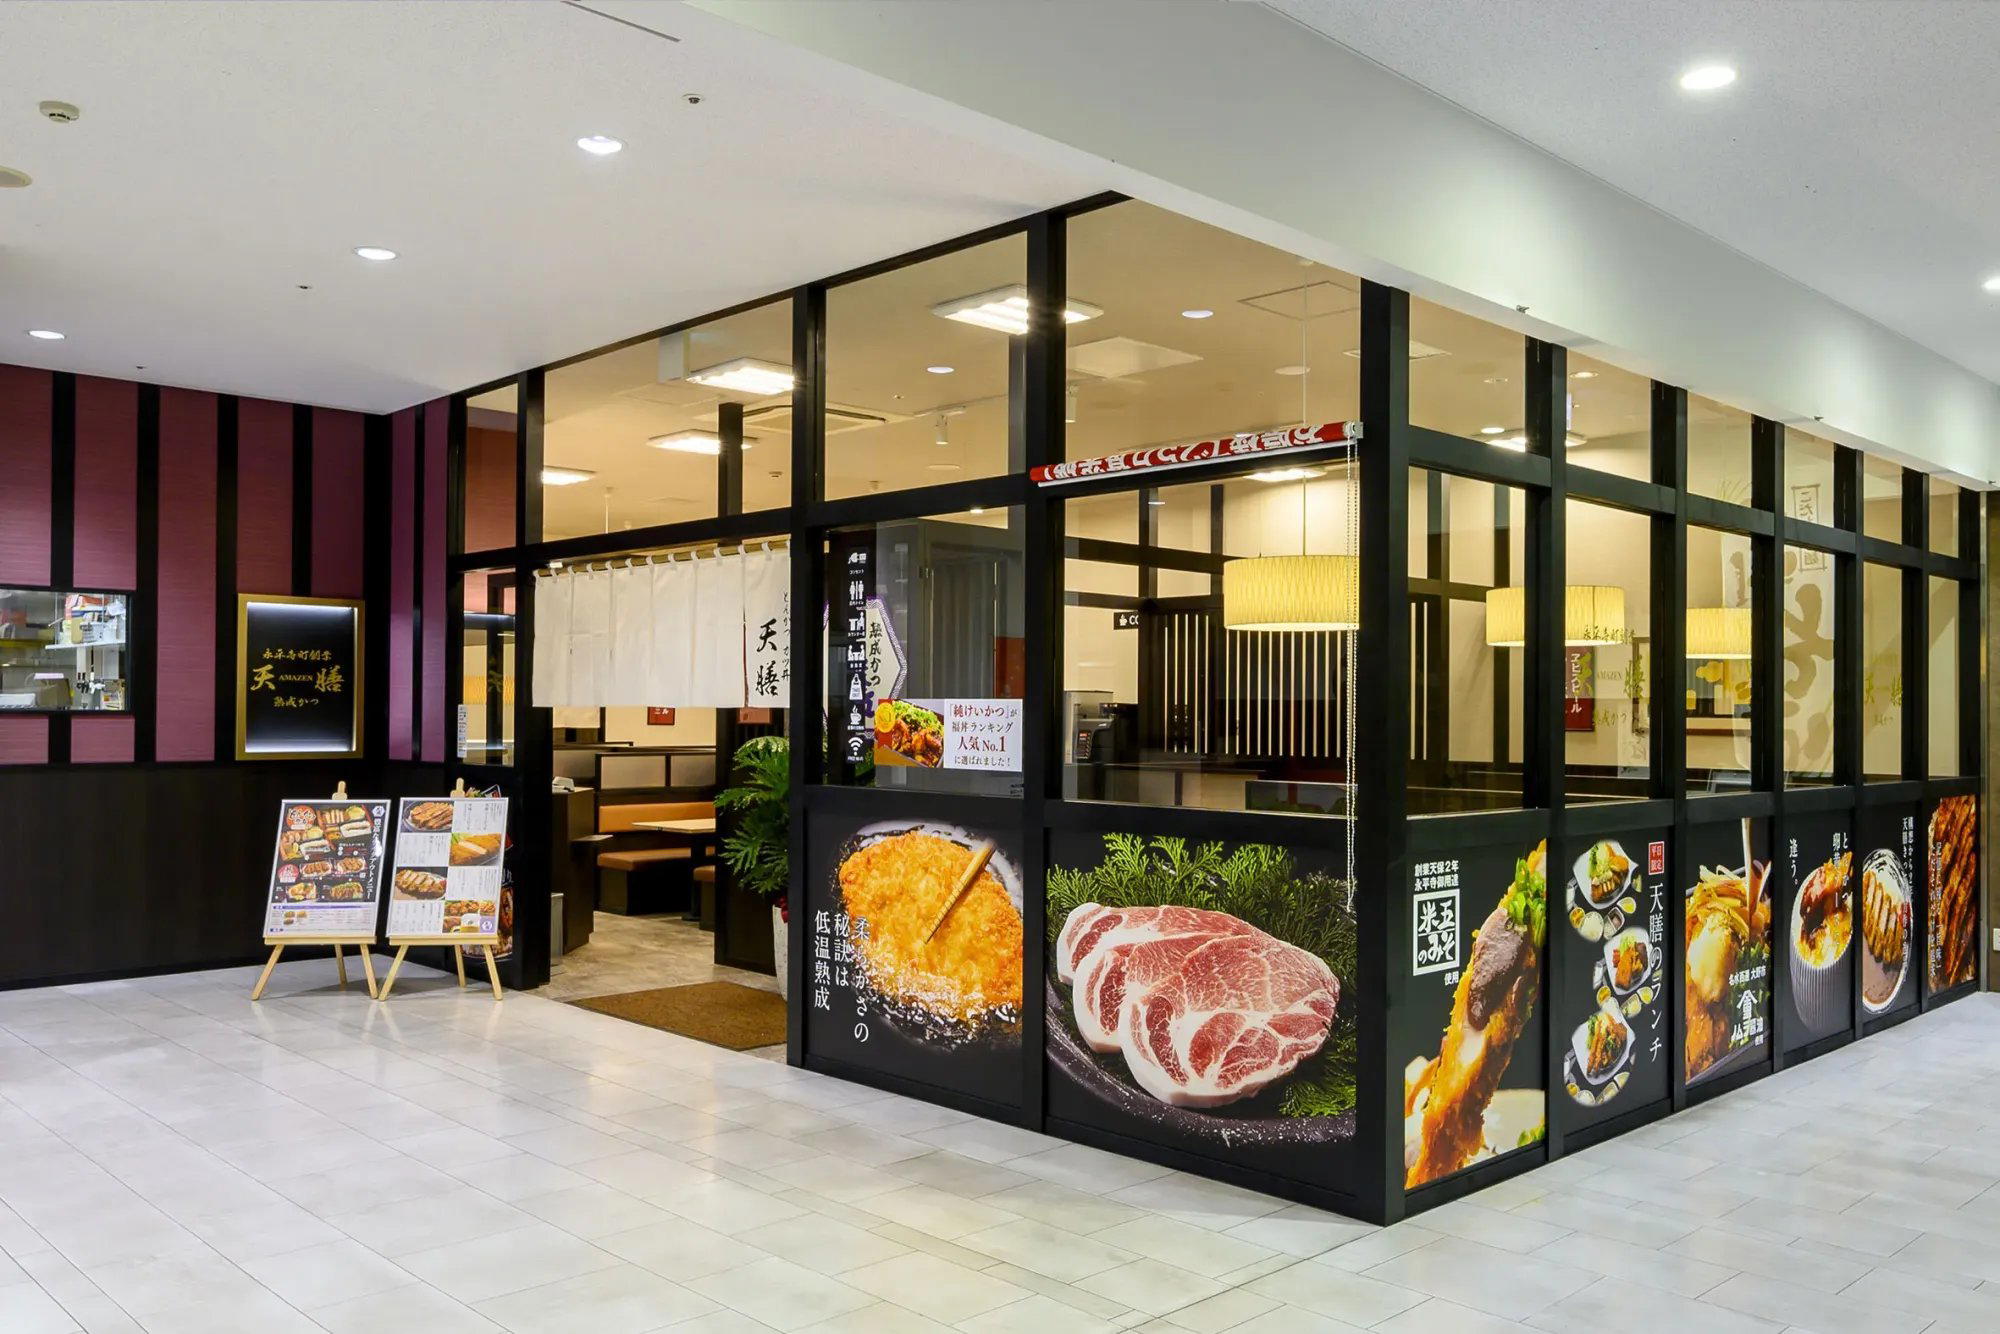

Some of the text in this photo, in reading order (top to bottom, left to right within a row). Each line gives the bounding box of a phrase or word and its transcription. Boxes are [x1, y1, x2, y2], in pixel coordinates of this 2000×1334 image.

[251, 664, 276, 691] 天
[756, 618, 780, 696] 天膳
[869, 622, 883, 687] 熟成かつ
[958, 735, 1006, 752] 人気 No.1
[1414, 860, 1459, 877] 創業天保2年
[1414, 873, 1459, 891] 永平寺御用達
[814, 909, 830, 1010] 低温熟成
[834, 911, 851, 986] 秘訣は
[853, 916, 869, 1042] 柔らかさの
[1444, 971, 1459, 985] 使用
[1649, 882, 1664, 1063] 天膳のランチ
